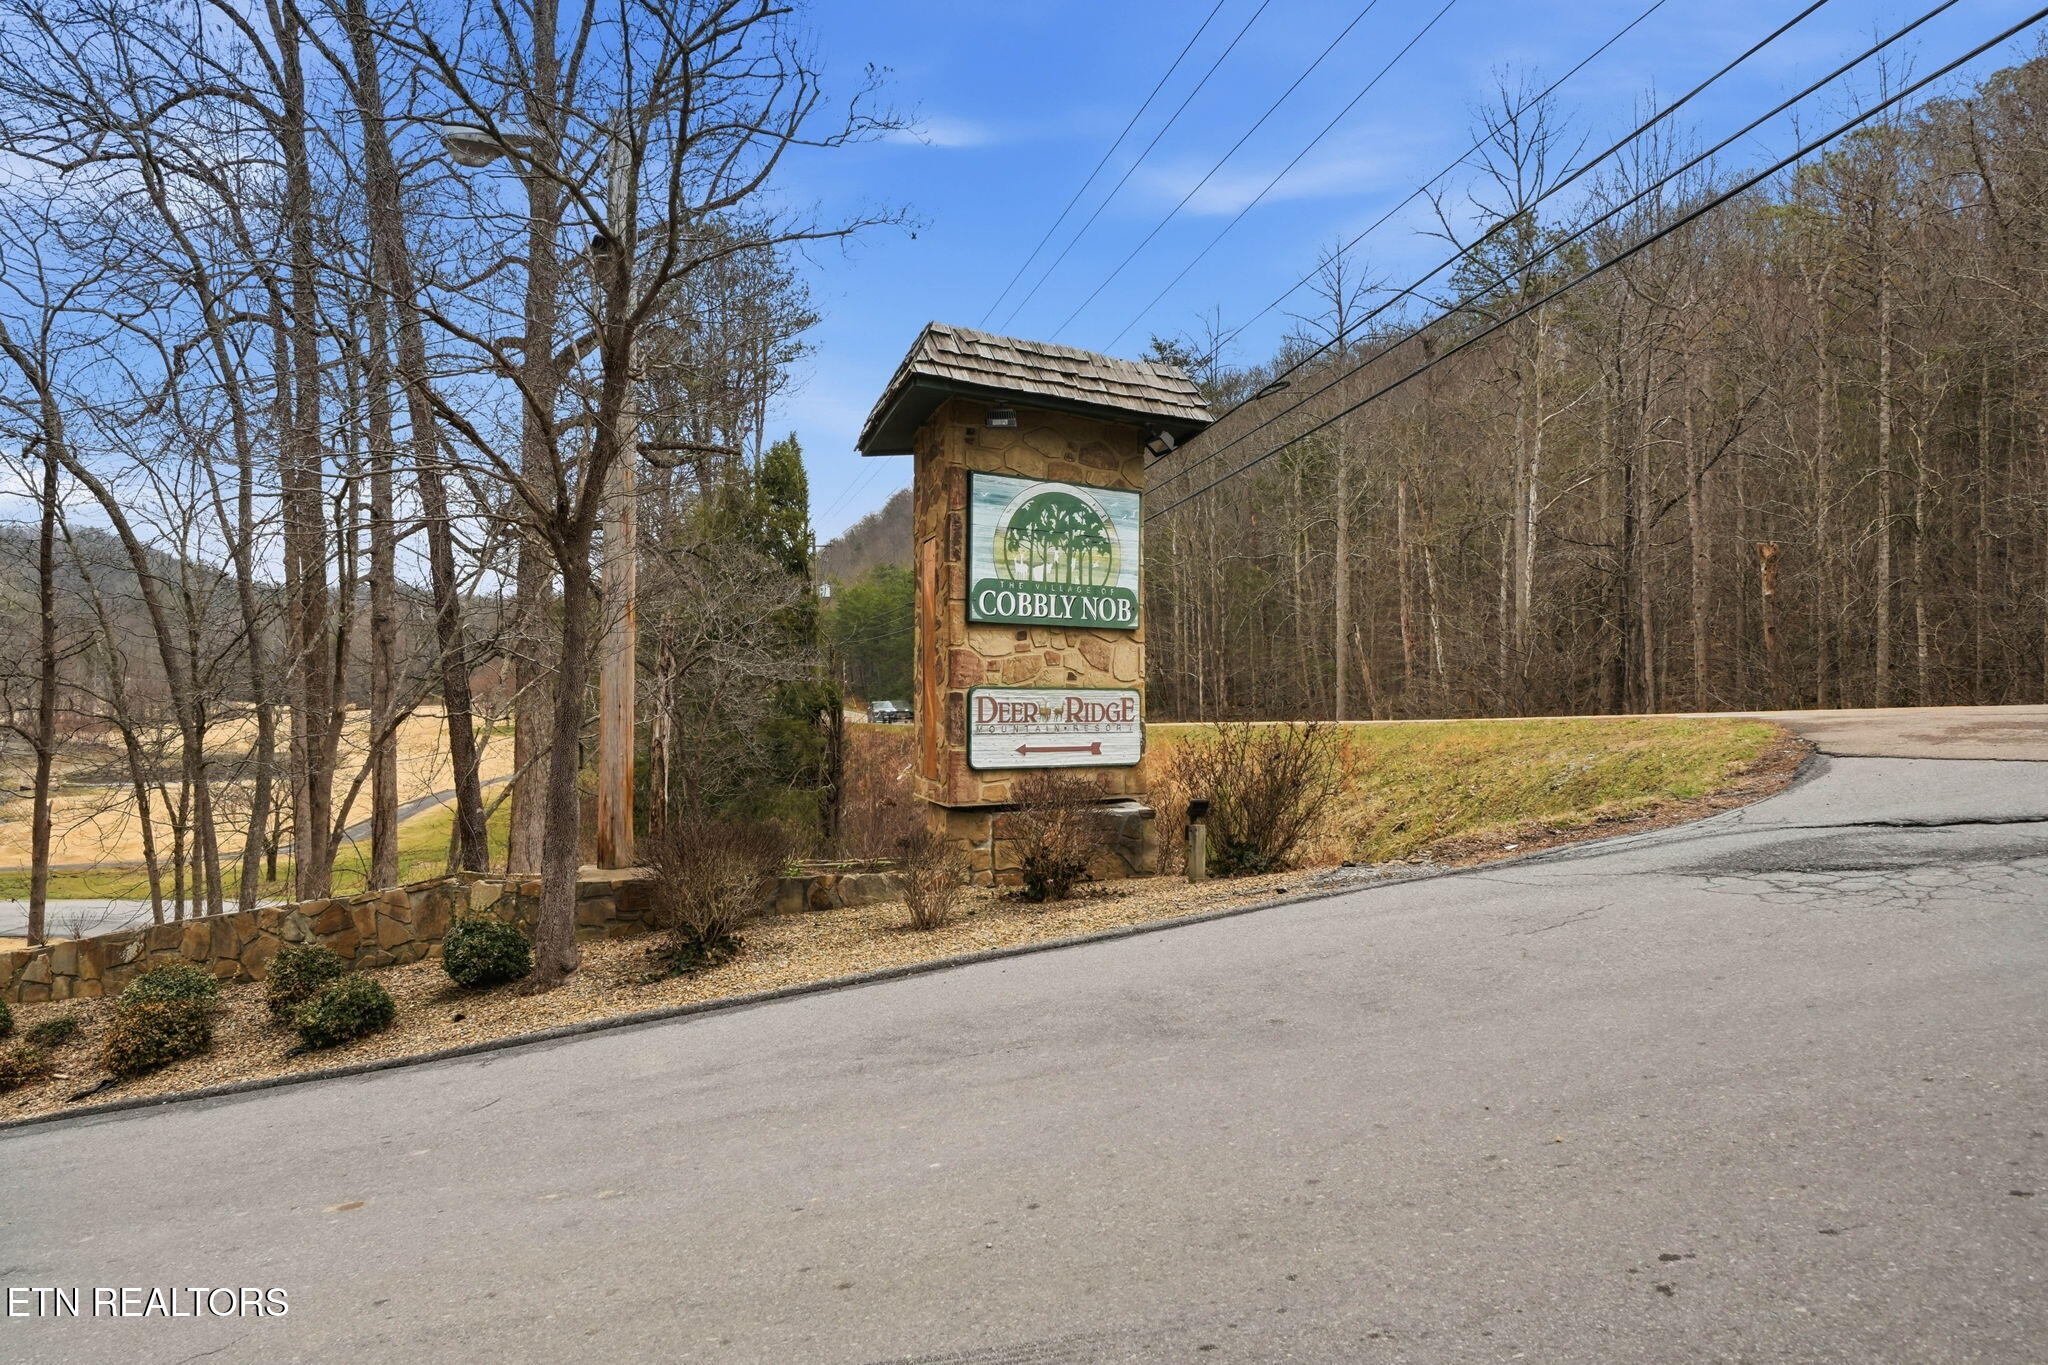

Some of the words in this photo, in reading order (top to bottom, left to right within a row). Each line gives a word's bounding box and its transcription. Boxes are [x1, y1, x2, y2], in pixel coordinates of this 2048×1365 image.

[1000, 581, 1024, 590] THE
[1035, 583, 1091, 594] VILLAGE
[1100, 587, 1115, 596] OF
[978, 590, 1077, 620] COBBLY
[1080, 596, 1132, 622] NOB
[975, 696, 1040, 724] DEER
[1064, 696, 1136, 724] RIDGE
[976, 724, 1060, 733] MOUNTAIN
[1073, 724, 1133, 732] RESORT
